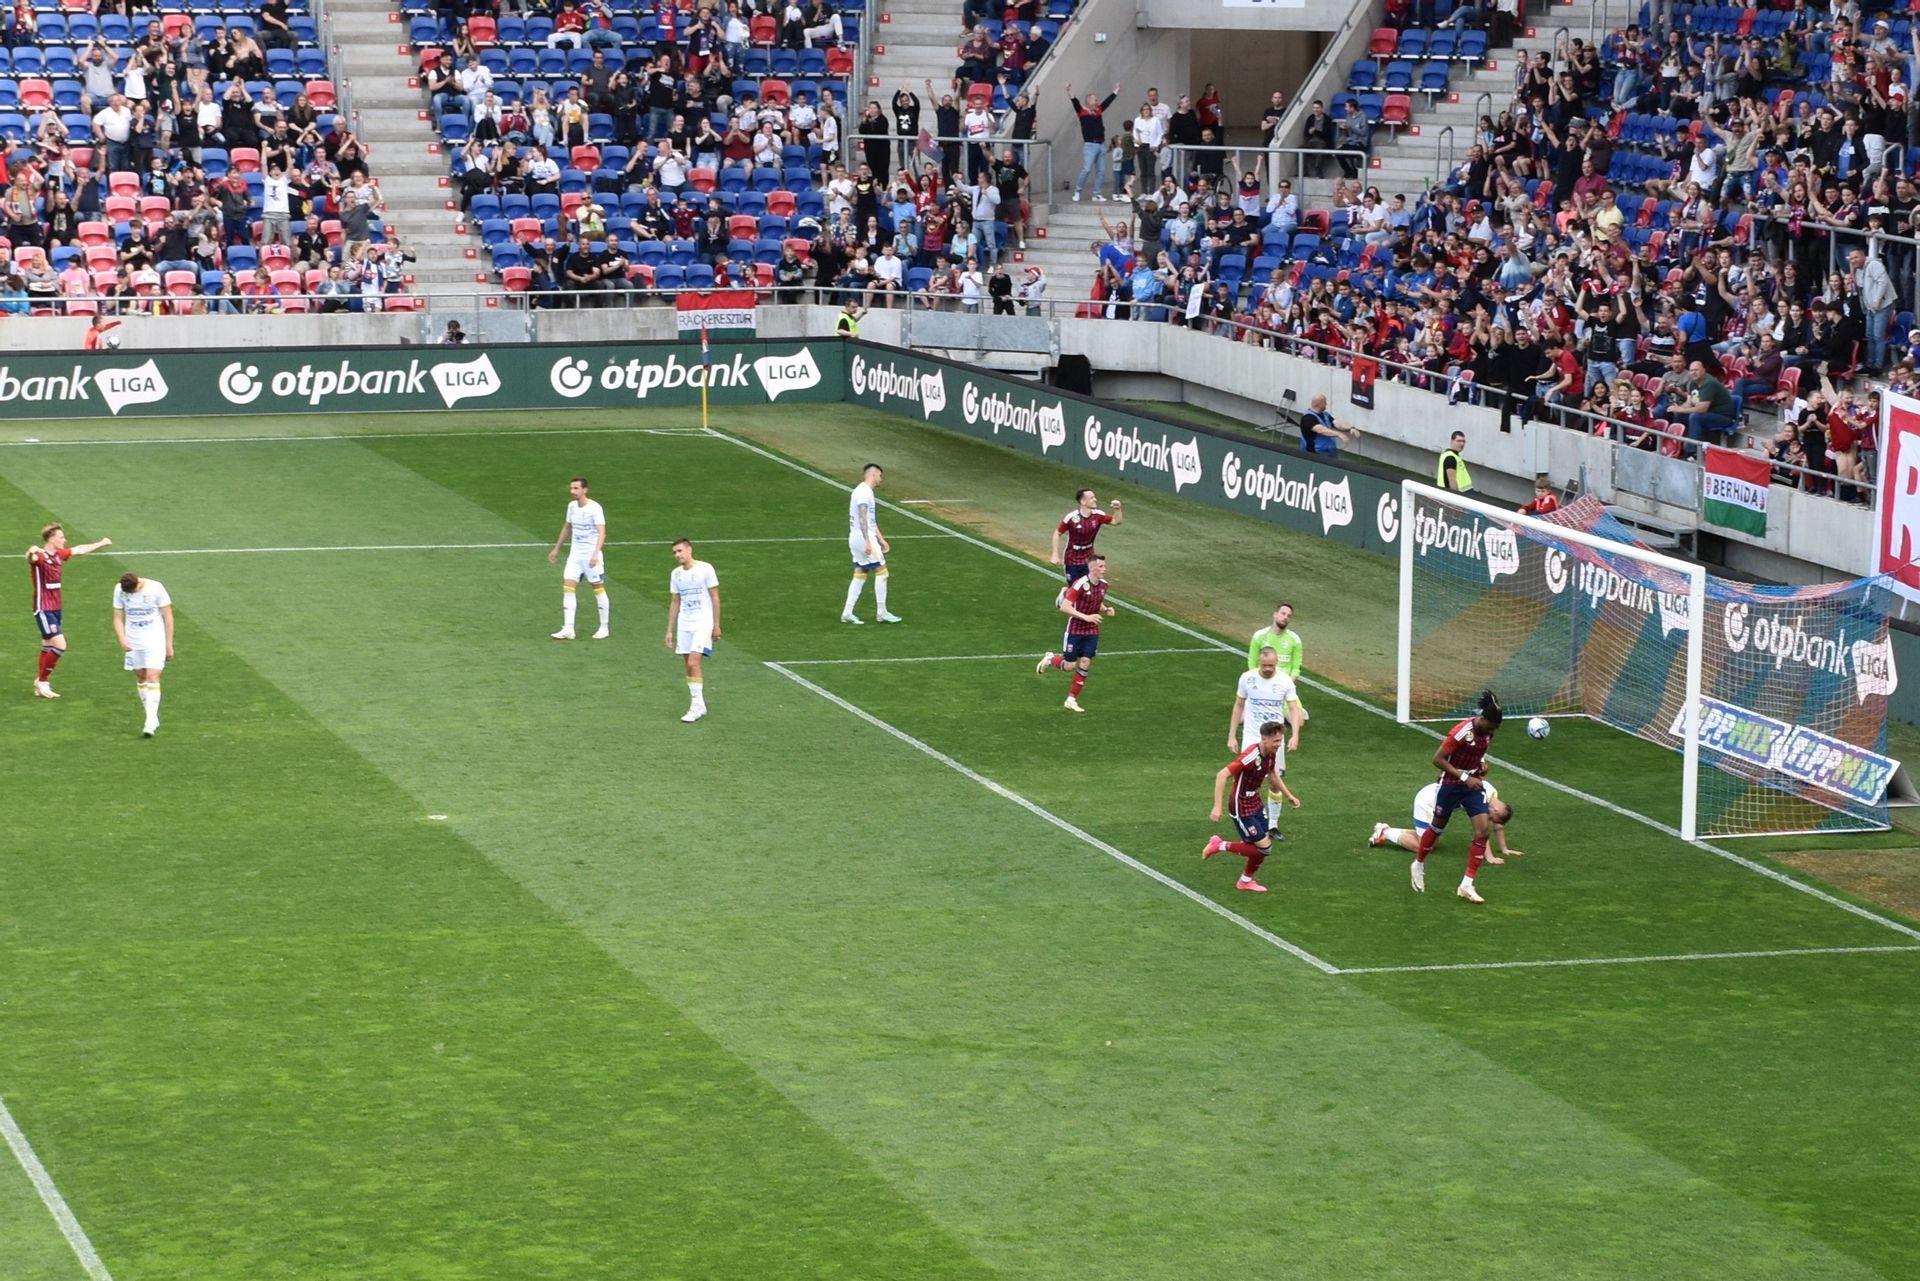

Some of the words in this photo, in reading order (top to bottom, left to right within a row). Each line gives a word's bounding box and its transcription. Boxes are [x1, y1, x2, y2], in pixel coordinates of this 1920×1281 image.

[110, 377, 156, 393] LIGA
[271, 359, 427, 405] otpbank
[445, 371, 489, 387] LIGA
[600, 352, 751, 399] otpbank
[769, 364, 810, 380] LIGA
[867, 362, 922, 403] otpbank
[925, 385, 942, 401] LIGA
[980, 392, 1039, 435] otpbank
[1043, 415, 1062, 435] LIGA
[1104, 426, 1171, 472] otpbank
[1177, 453, 1197, 473] LIGA
[1244, 464, 1318, 511] otpbank
[1325, 491, 1348, 513] LIGA
[1713, 478, 1759, 507] BERHIDA
[1415, 507, 1482, 561] tpbank
[1491, 537, 1514, 563] LIGA
[1753, 614, 1850, 677] otpbank
[1860, 653, 1890, 681] LIGA
